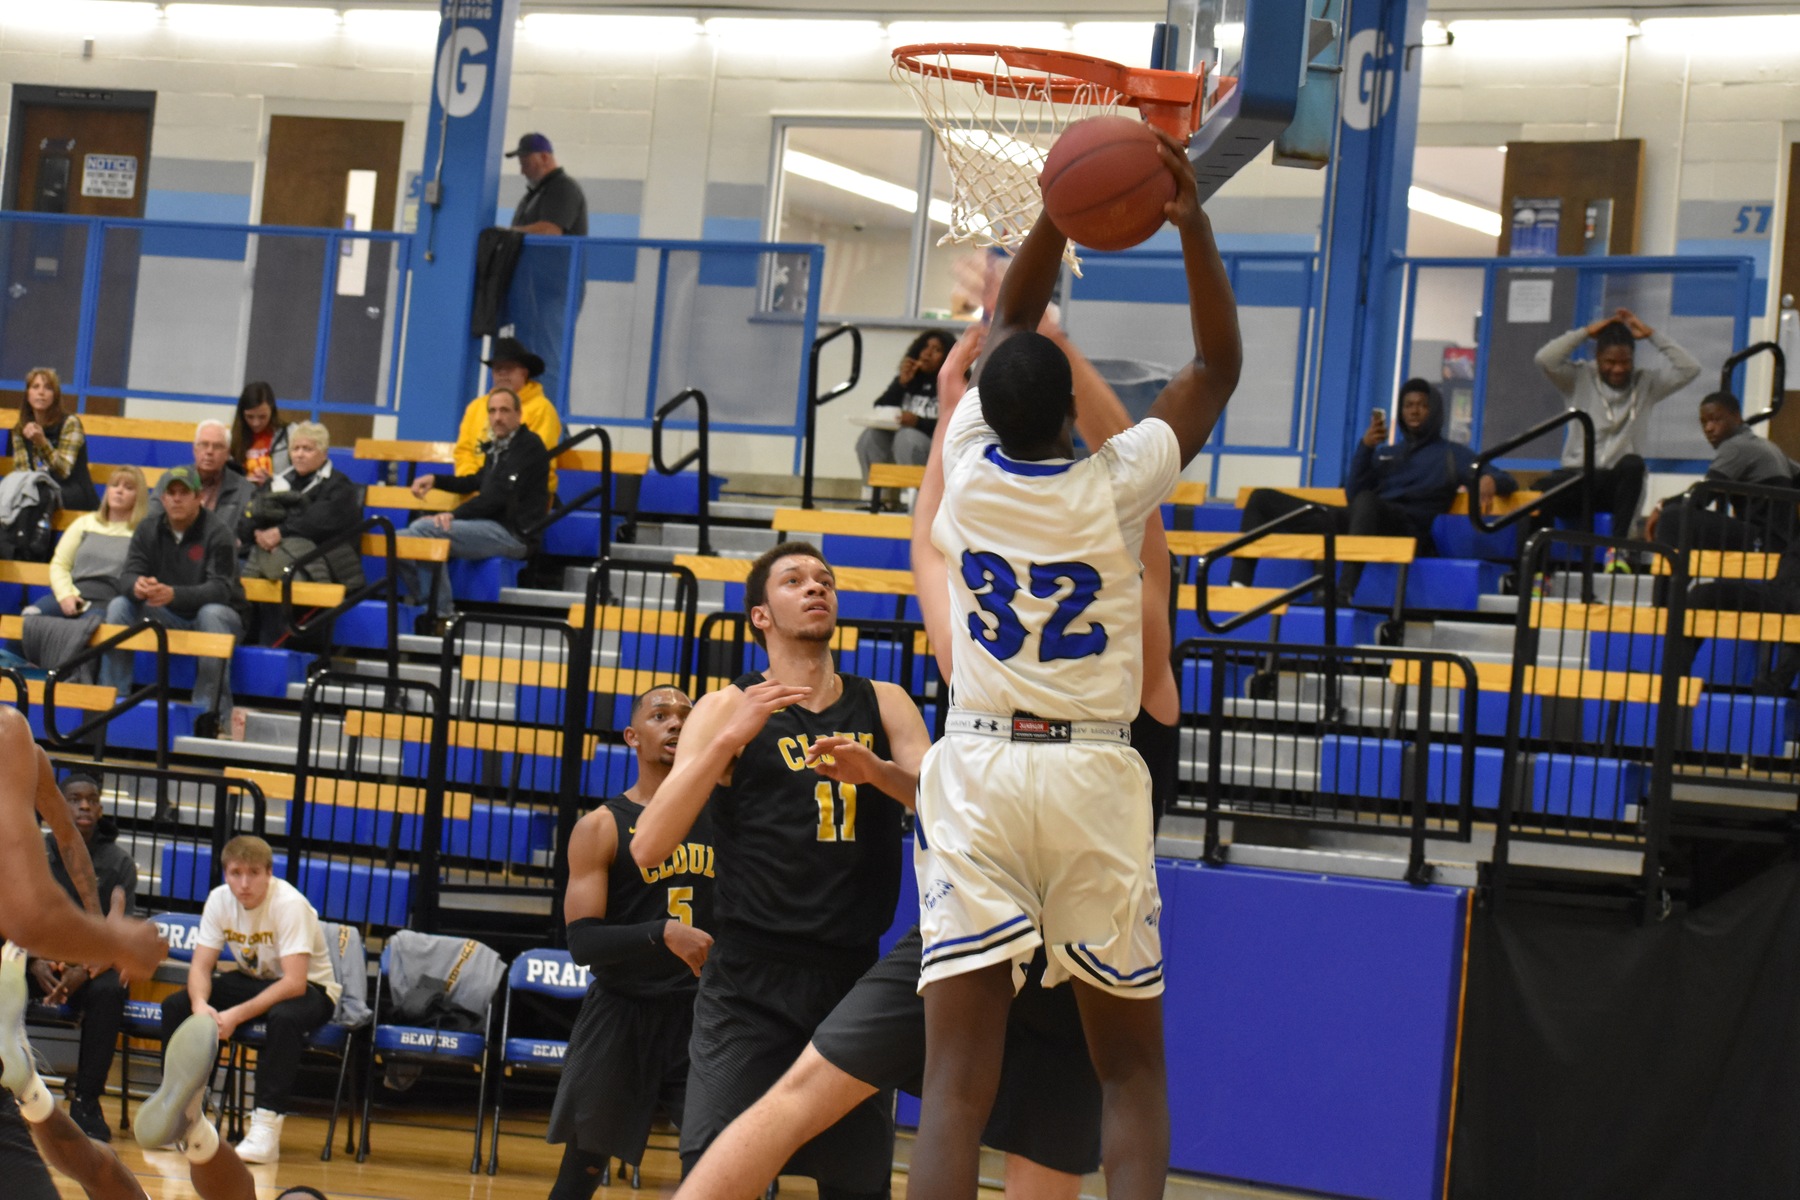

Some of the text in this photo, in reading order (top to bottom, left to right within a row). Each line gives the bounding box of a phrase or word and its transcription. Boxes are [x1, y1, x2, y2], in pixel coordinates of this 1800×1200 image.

[444, 5, 492, 20] SATING
[437, 26, 488, 118] G
[1342, 28, 1394, 131] G
[87, 156, 134, 171] NOTICE
[1733, 206, 1772, 233] 57
[961, 549, 1109, 662] 32
[814, 781, 857, 842] 11
[667, 886, 693, 928] 5
[400, 1032, 458, 1049] BEAVERS
